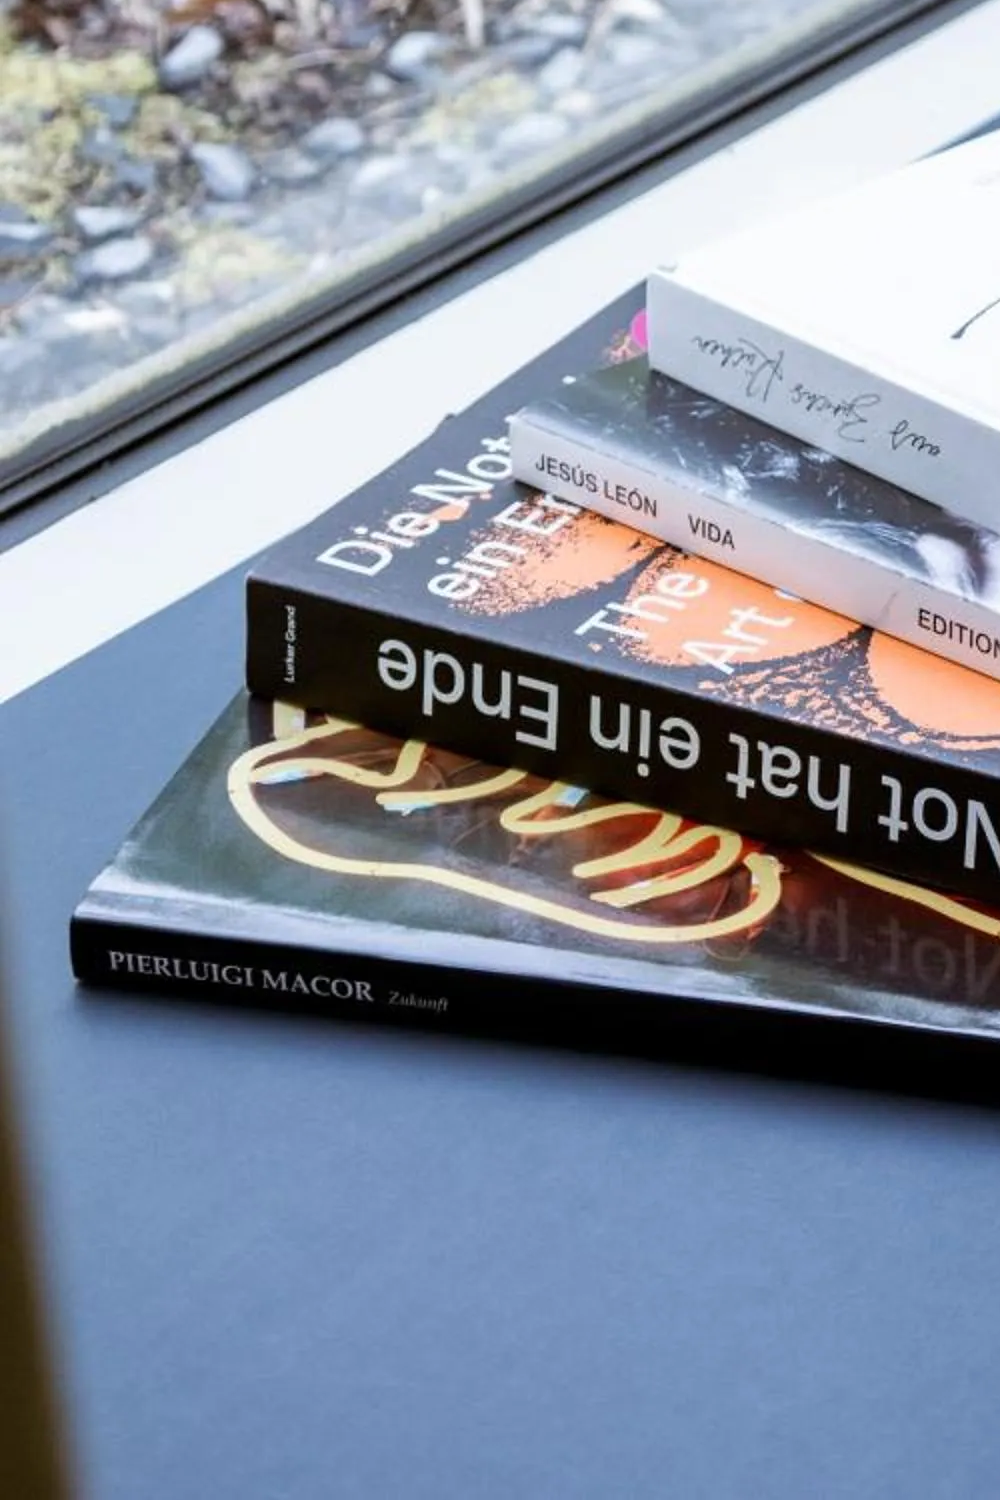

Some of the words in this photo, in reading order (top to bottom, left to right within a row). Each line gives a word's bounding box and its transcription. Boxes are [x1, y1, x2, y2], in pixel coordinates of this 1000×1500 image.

[535, 454, 598, 494] JESÚS
[603, 479, 658, 519] LEÓN
[687, 513, 735, 550] VIDA
[315, 512, 440, 578] Die
[427, 540, 528, 601] ein
[574, 572, 710, 639] The
[682, 606, 795, 676] Art
[377, 639, 559, 751] Ende
[589, 694, 700, 778] ein
[725, 732, 851, 833] hat
[108, 949, 254, 988] PIERLUIGI
[262, 969, 375, 1003] MACOR
[388, 990, 450, 1013] Zukunft
